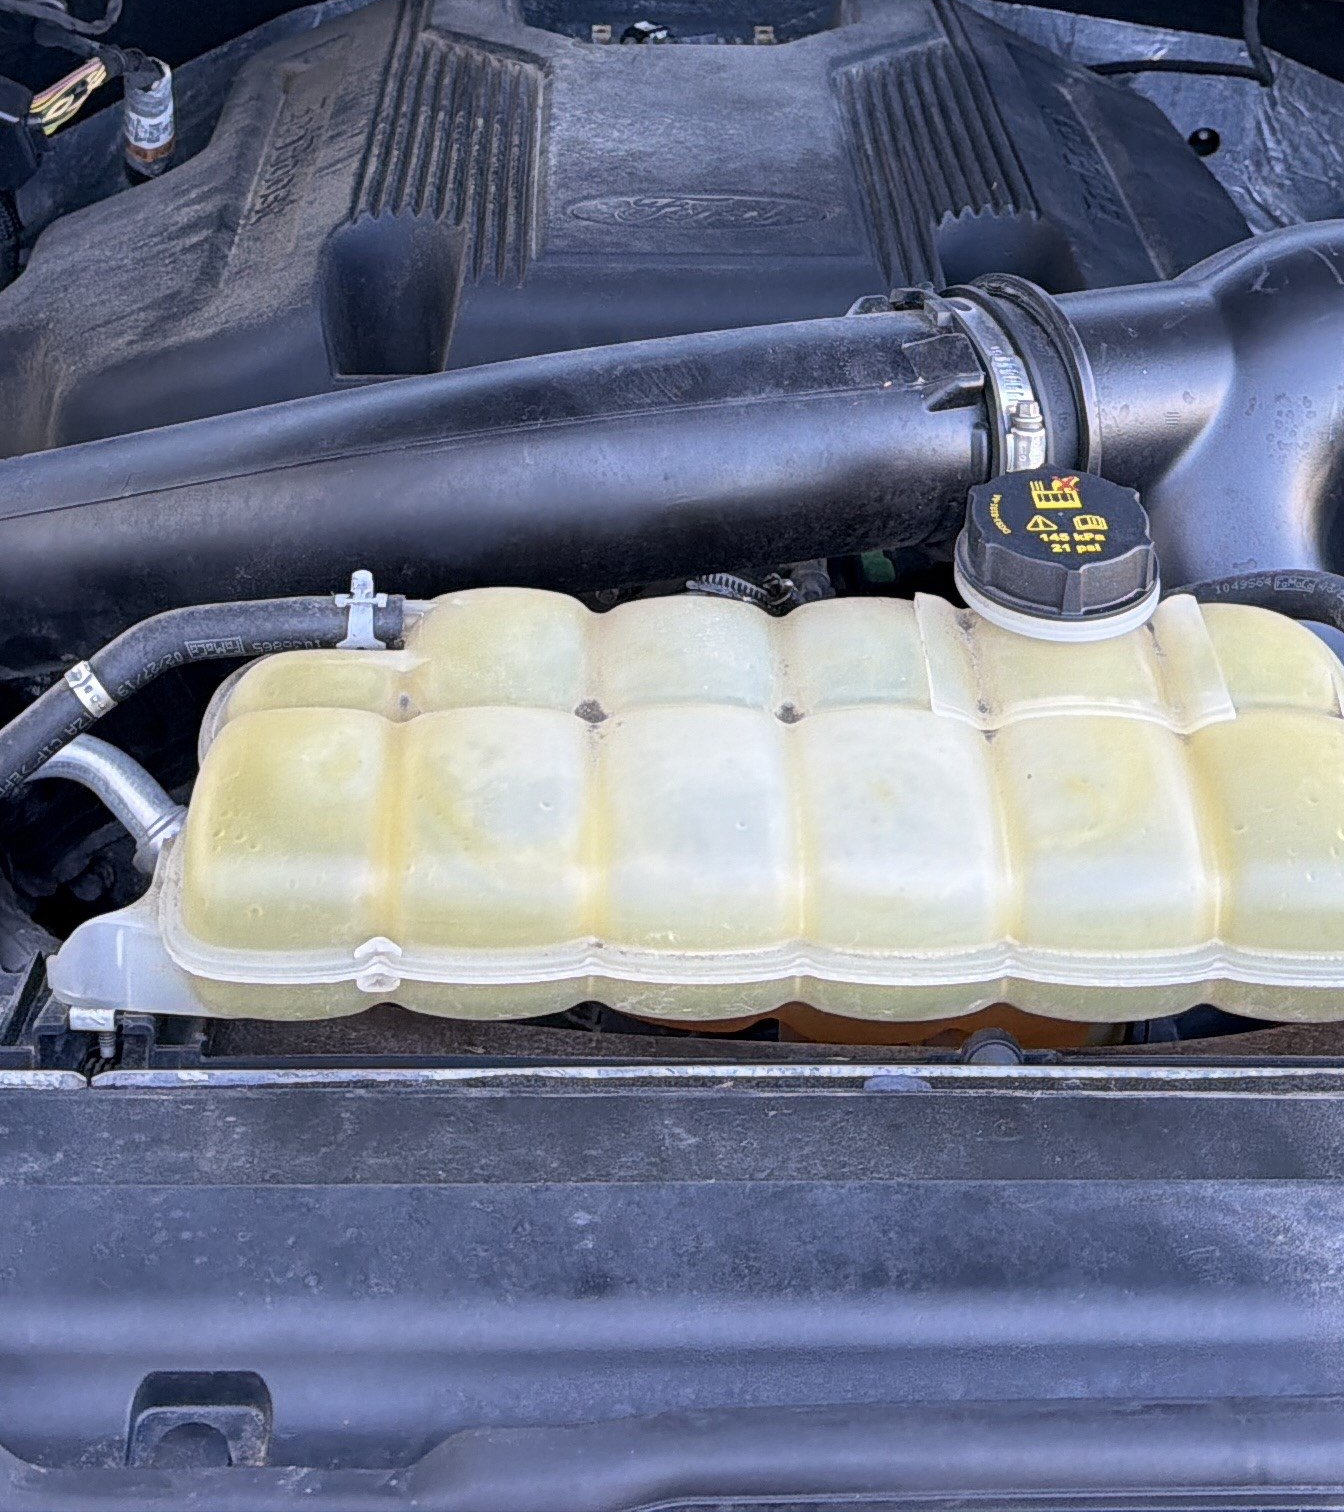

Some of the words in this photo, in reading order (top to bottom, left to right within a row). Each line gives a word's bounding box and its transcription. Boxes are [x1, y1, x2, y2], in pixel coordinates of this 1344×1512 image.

[1039, 533, 1070, 542] 145
[1073, 532, 1106, 542] kPa
[1051, 544, 1071, 553] 21
[1076, 544, 1103, 554] psi
[188, 641, 243, 658] FoMoCo
